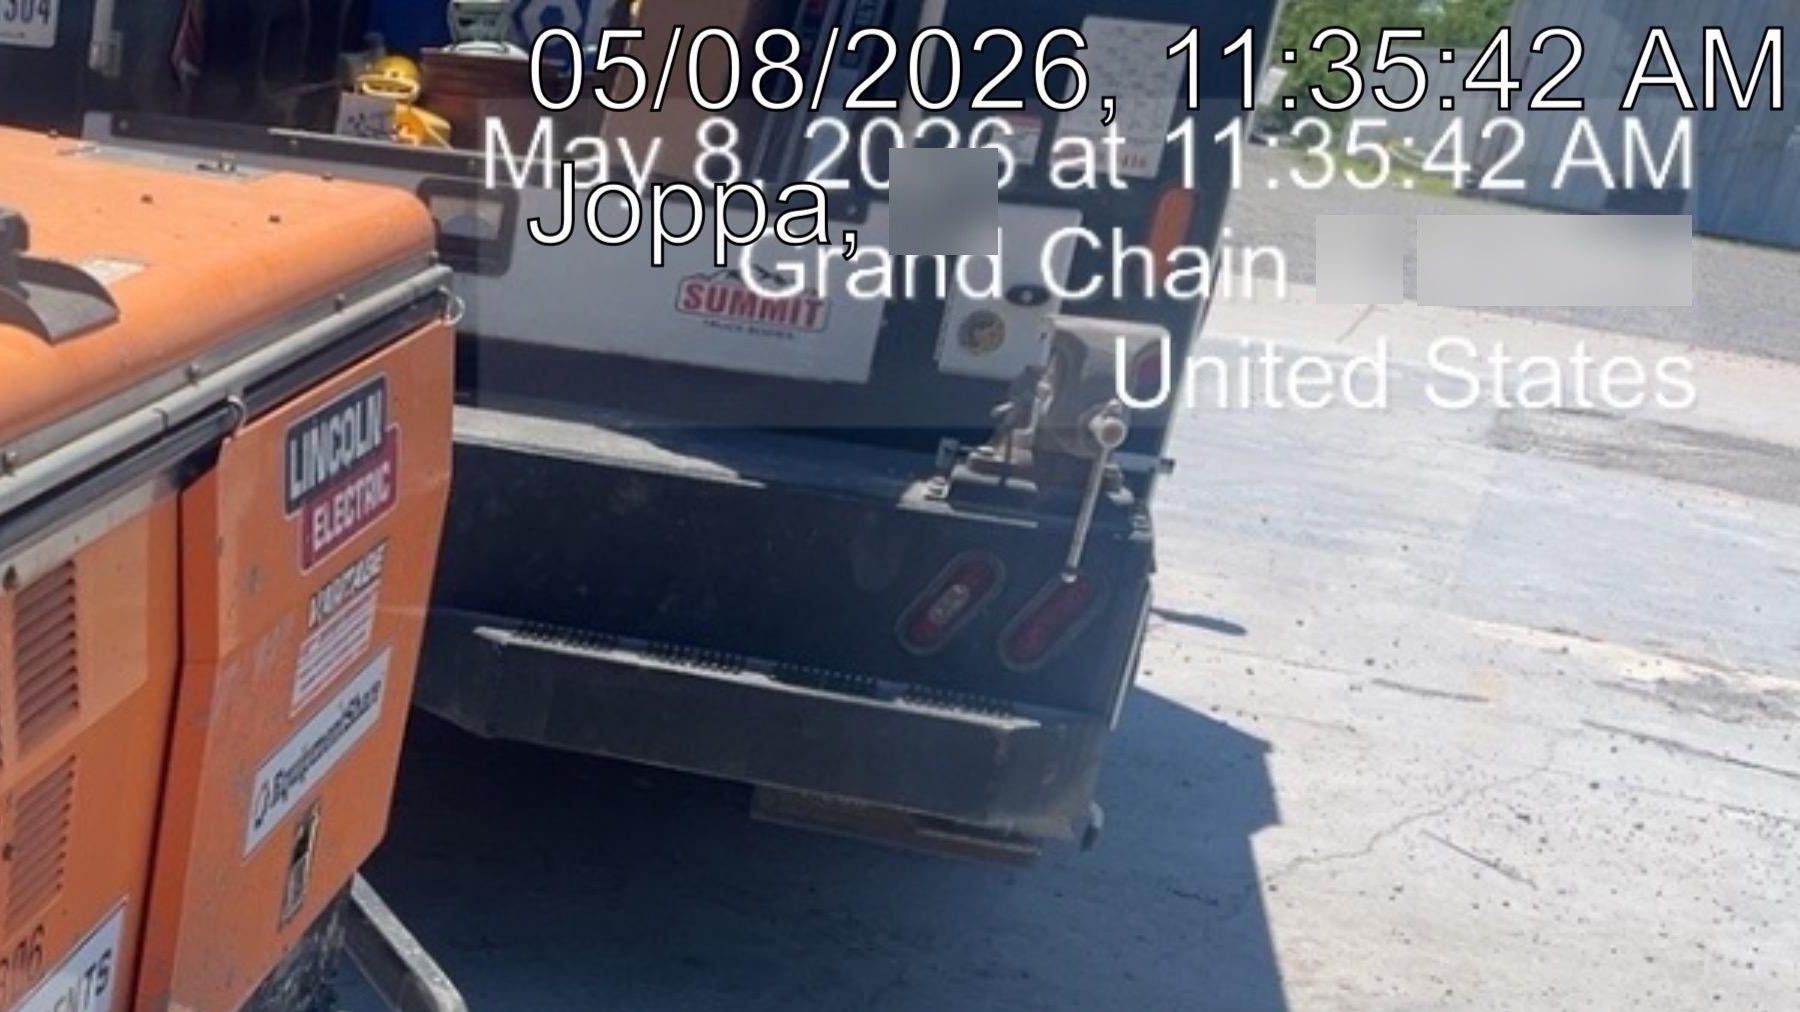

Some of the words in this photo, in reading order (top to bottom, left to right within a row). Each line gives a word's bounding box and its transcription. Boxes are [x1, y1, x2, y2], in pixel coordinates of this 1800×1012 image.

[683, 284, 823, 327] SUMMIT
[290, 390, 382, 500] LINCOLN
[312, 460, 391, 551] ELECTRIC
